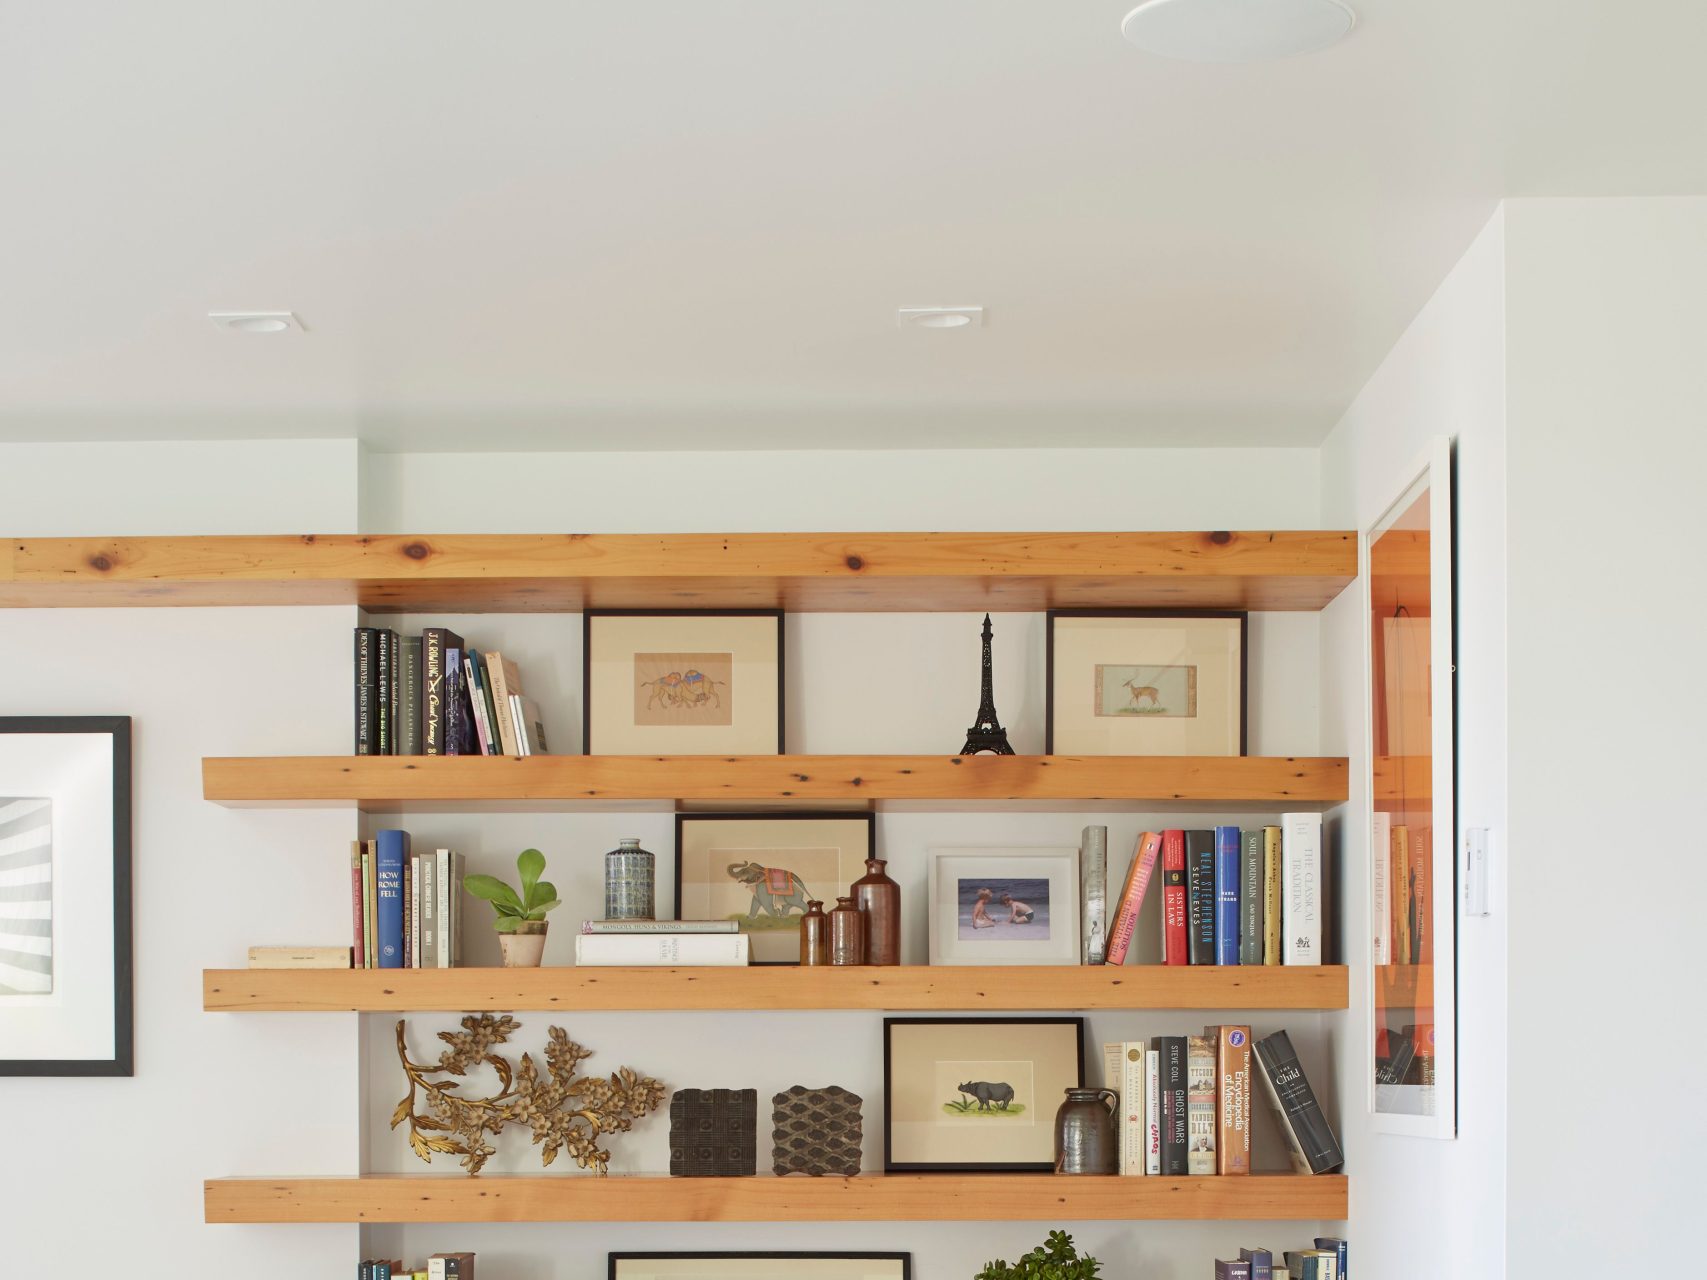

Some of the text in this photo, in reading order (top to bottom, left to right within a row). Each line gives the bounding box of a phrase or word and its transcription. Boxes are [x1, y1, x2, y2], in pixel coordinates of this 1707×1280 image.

[360, 632, 368, 684] DEN OF THIEVES
[360, 685, 368, 706] JAMES
[360, 712, 368, 740] STEWART
[1249, 837, 1257, 898] SOUL MOUNTAIN
[1292, 857, 1302, 913] TRADITION
[1304, 847, 1314, 925] THE CLASSICAL
[380, 890, 398, 898] FELL
[1168, 893, 1175, 903] IN
[1176, 892, 1184, 927] SISTERS
[1192, 866, 1200, 925] SEVENEVES
[1200, 852, 1212, 943] NEAL STEPHENSON
[1119, 913, 1137, 949] SOLUTION
[1171, 1045, 1179, 1083] STEVE COLL
[1191, 1069, 1214, 1077] TYCOON
[1276, 1068, 1300, 1085] Child
[1175, 1089, 1185, 1144] GHOST WARS
[1225, 1074, 1234, 1128] of Medicine
[1233, 1071, 1244, 1131] Encyclopedia
[1191, 1122, 1214, 1134] BILT
